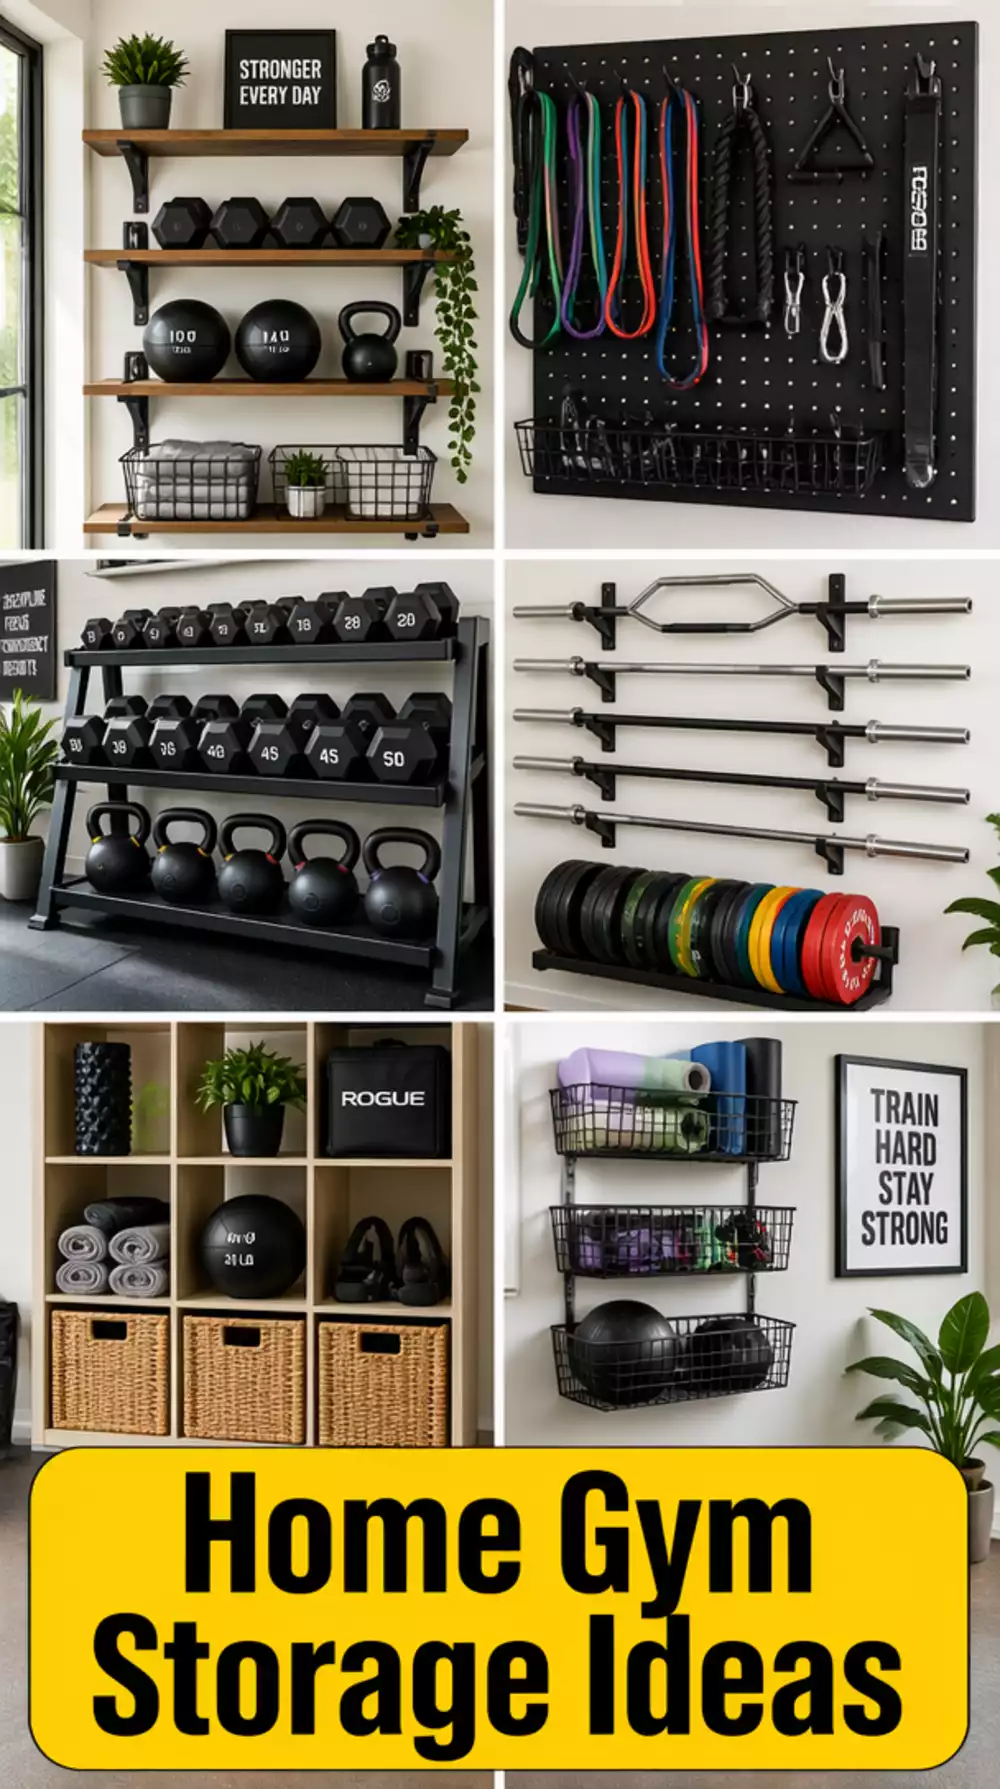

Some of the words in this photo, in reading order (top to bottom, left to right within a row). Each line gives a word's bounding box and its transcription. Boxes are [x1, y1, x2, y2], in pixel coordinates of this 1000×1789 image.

[239, 59, 322, 80] STRONGER
[239, 86, 288, 106] EVERY
[292, 86, 322, 106] DAY
[341, 1091, 425, 1106] ROGUE
[870, 1088, 939, 1127] TRAIN
[876, 1129, 937, 1166] HARD
[879, 1170, 934, 1205] STAY
[861, 1210, 948, 1245] STRONG
